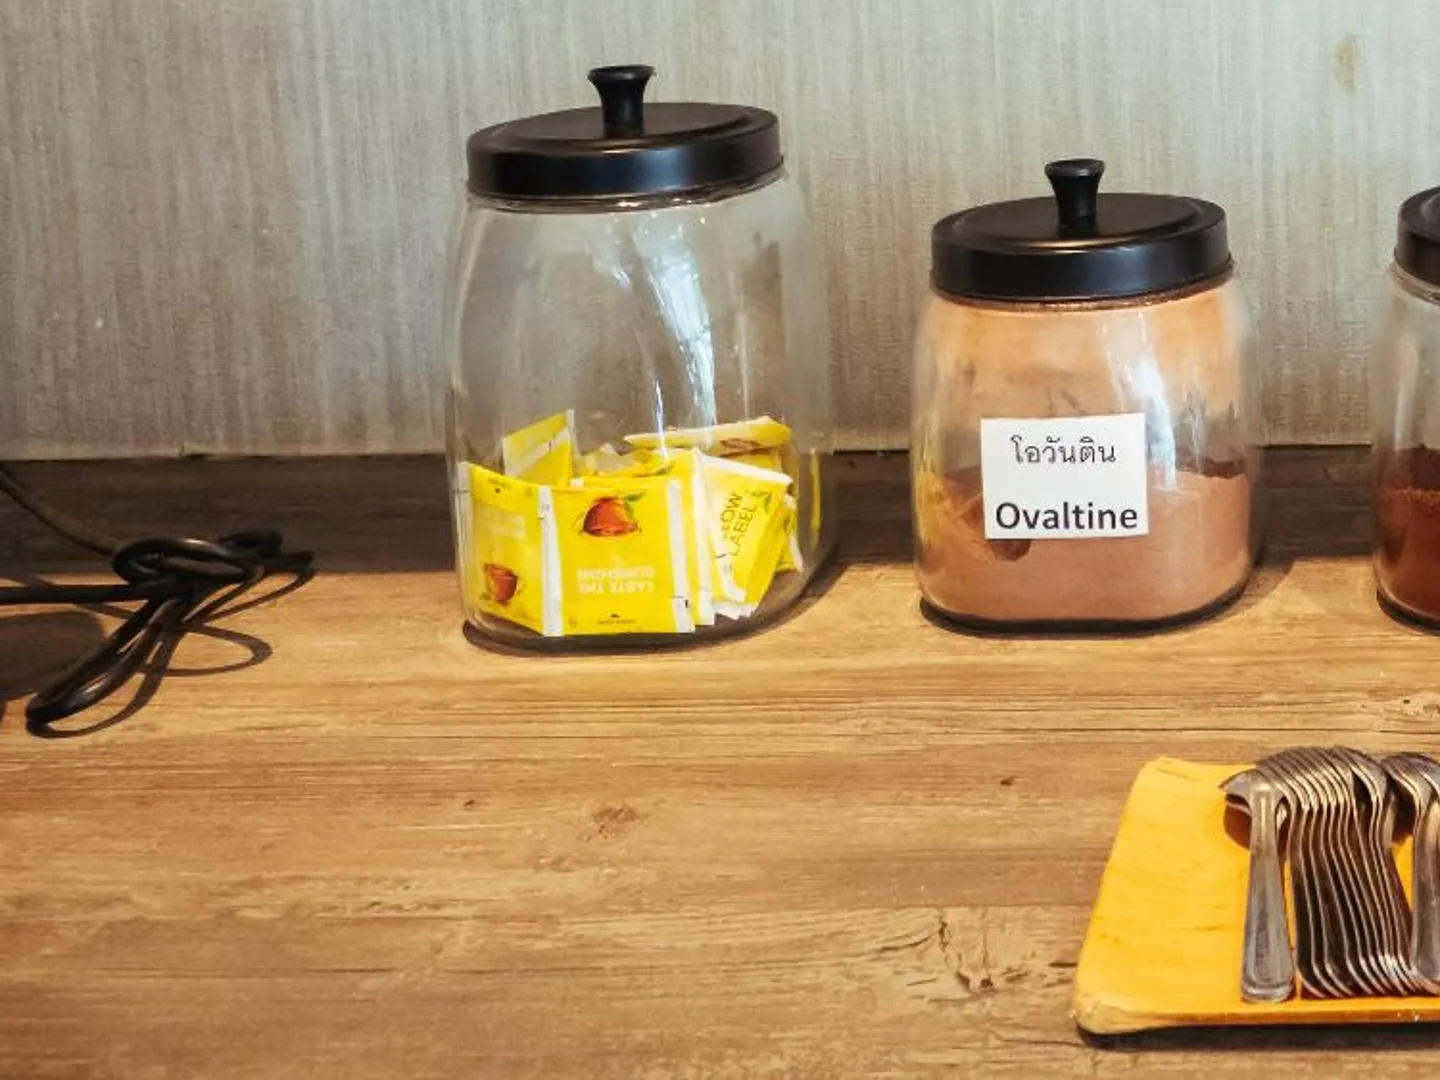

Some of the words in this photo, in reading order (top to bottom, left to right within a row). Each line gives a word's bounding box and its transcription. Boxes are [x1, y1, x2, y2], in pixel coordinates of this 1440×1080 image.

[1010, 434, 1117, 464] โอวันติน
[728, 503, 757, 557] LABEL
[995, 501, 1138, 530] Ovaltine
